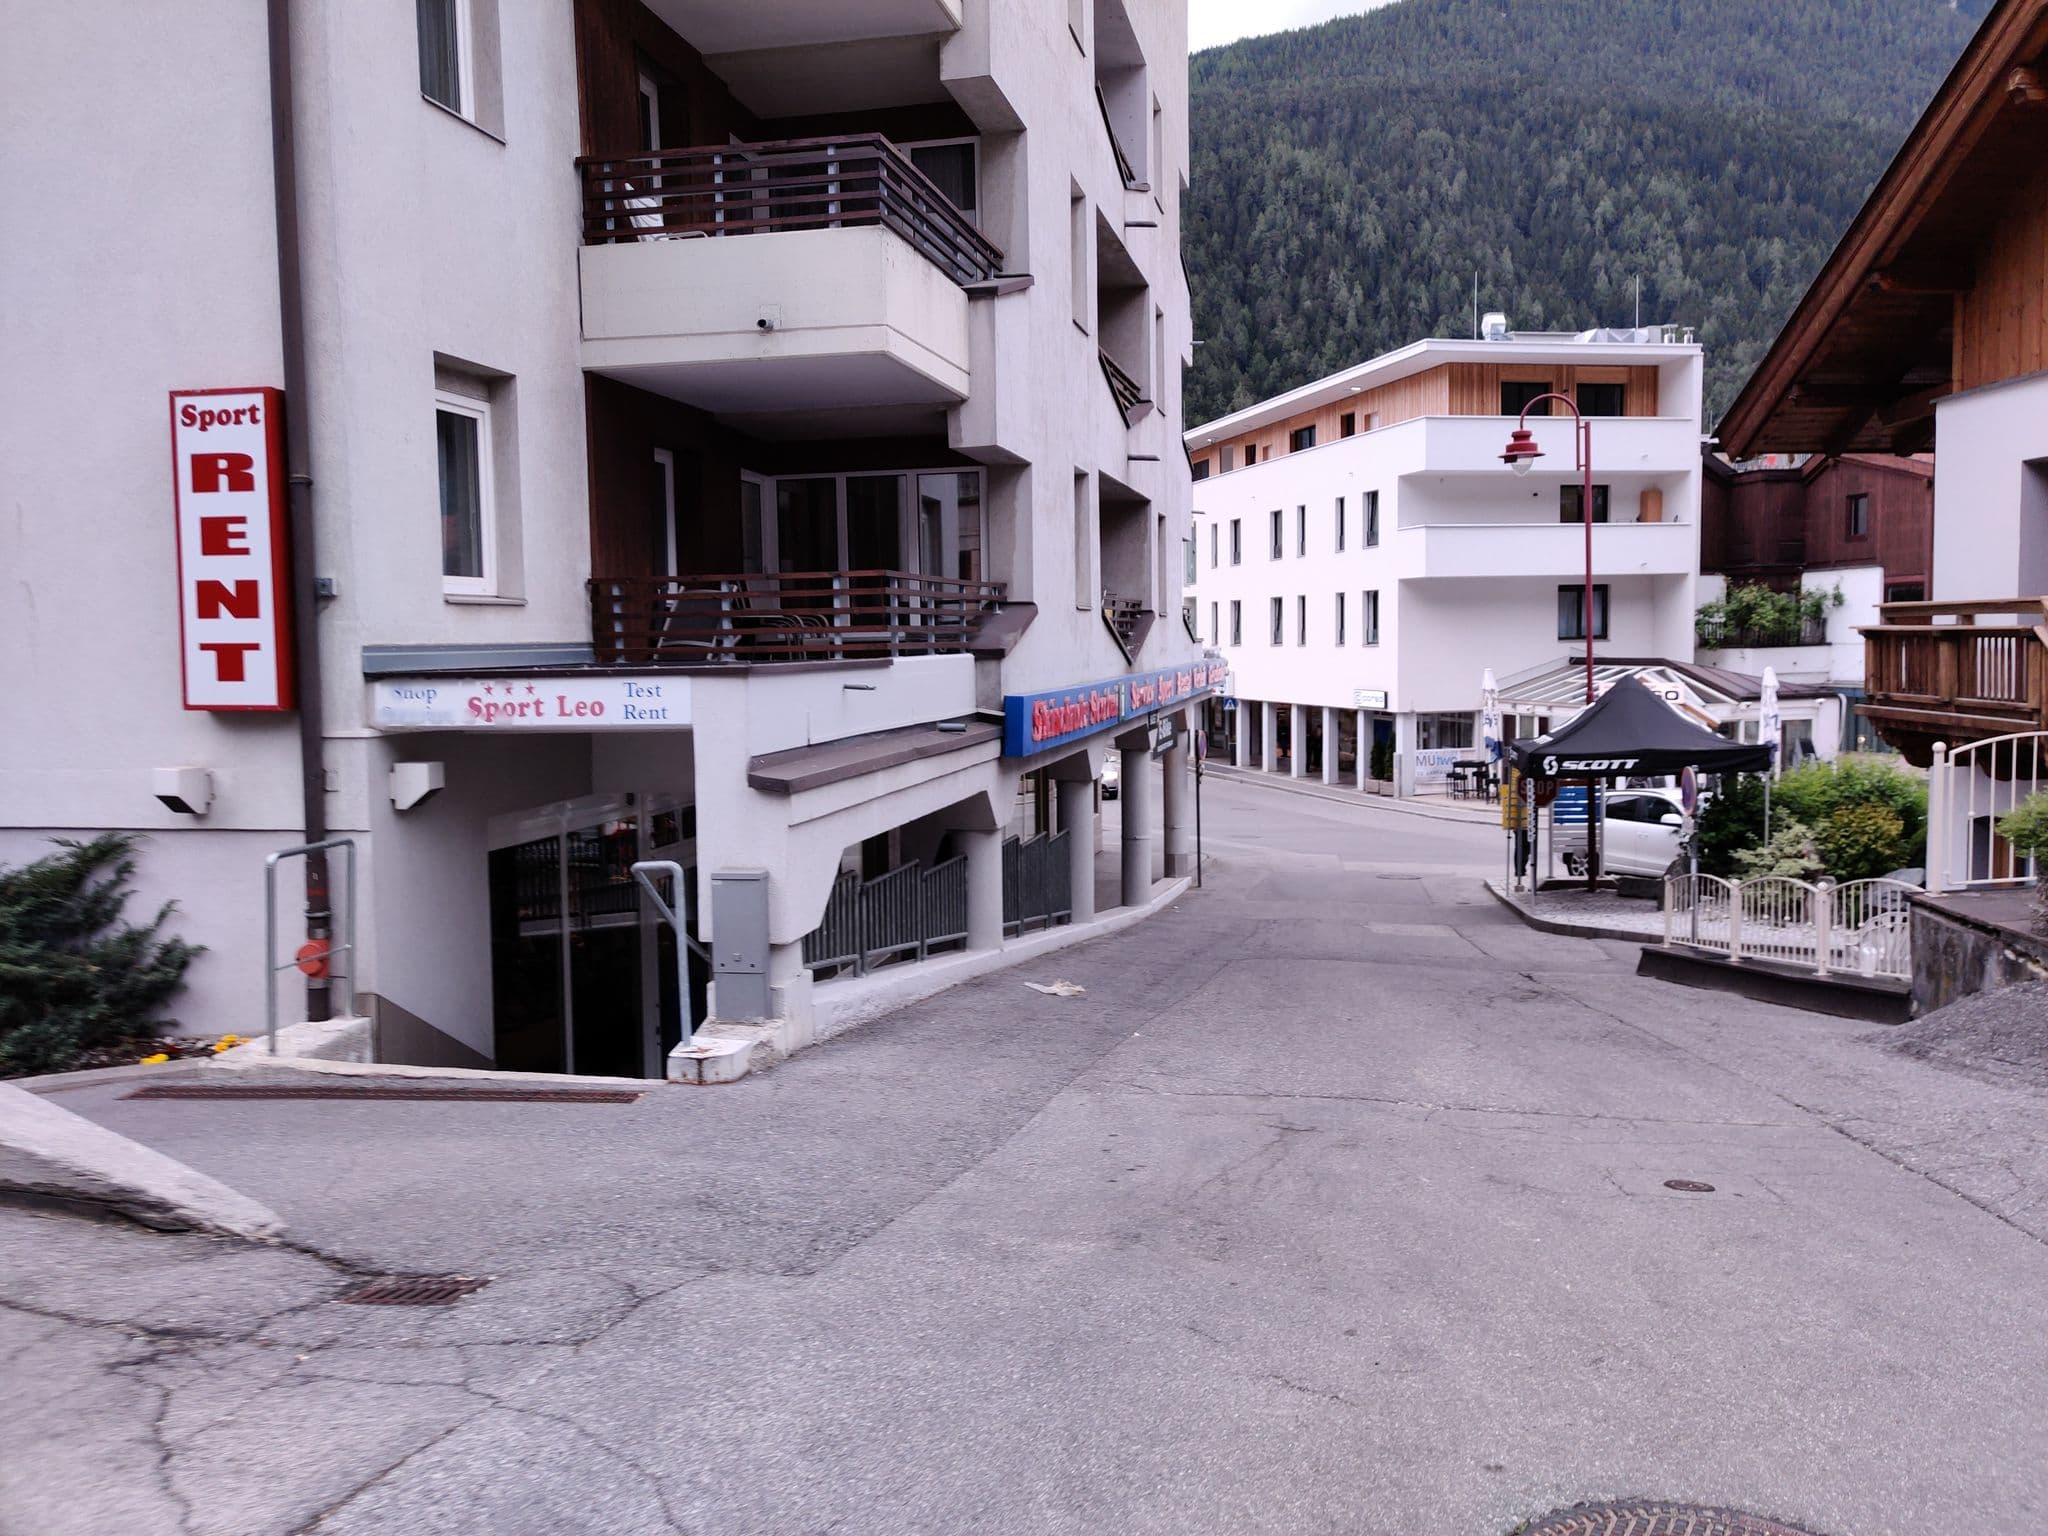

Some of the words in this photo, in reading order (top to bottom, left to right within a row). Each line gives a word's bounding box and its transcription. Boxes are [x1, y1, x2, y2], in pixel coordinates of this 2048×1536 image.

[180, 403, 261, 431] Sport
[190, 452, 261, 682] RENT
[623, 682, 662, 697] Test
[467, 695, 545, 722] Sport
[557, 695, 605, 717] Leo
[623, 704, 668, 720] Rent
[1560, 758, 1640, 770] SCOTT
[1520, 780, 1554, 796] SOP
